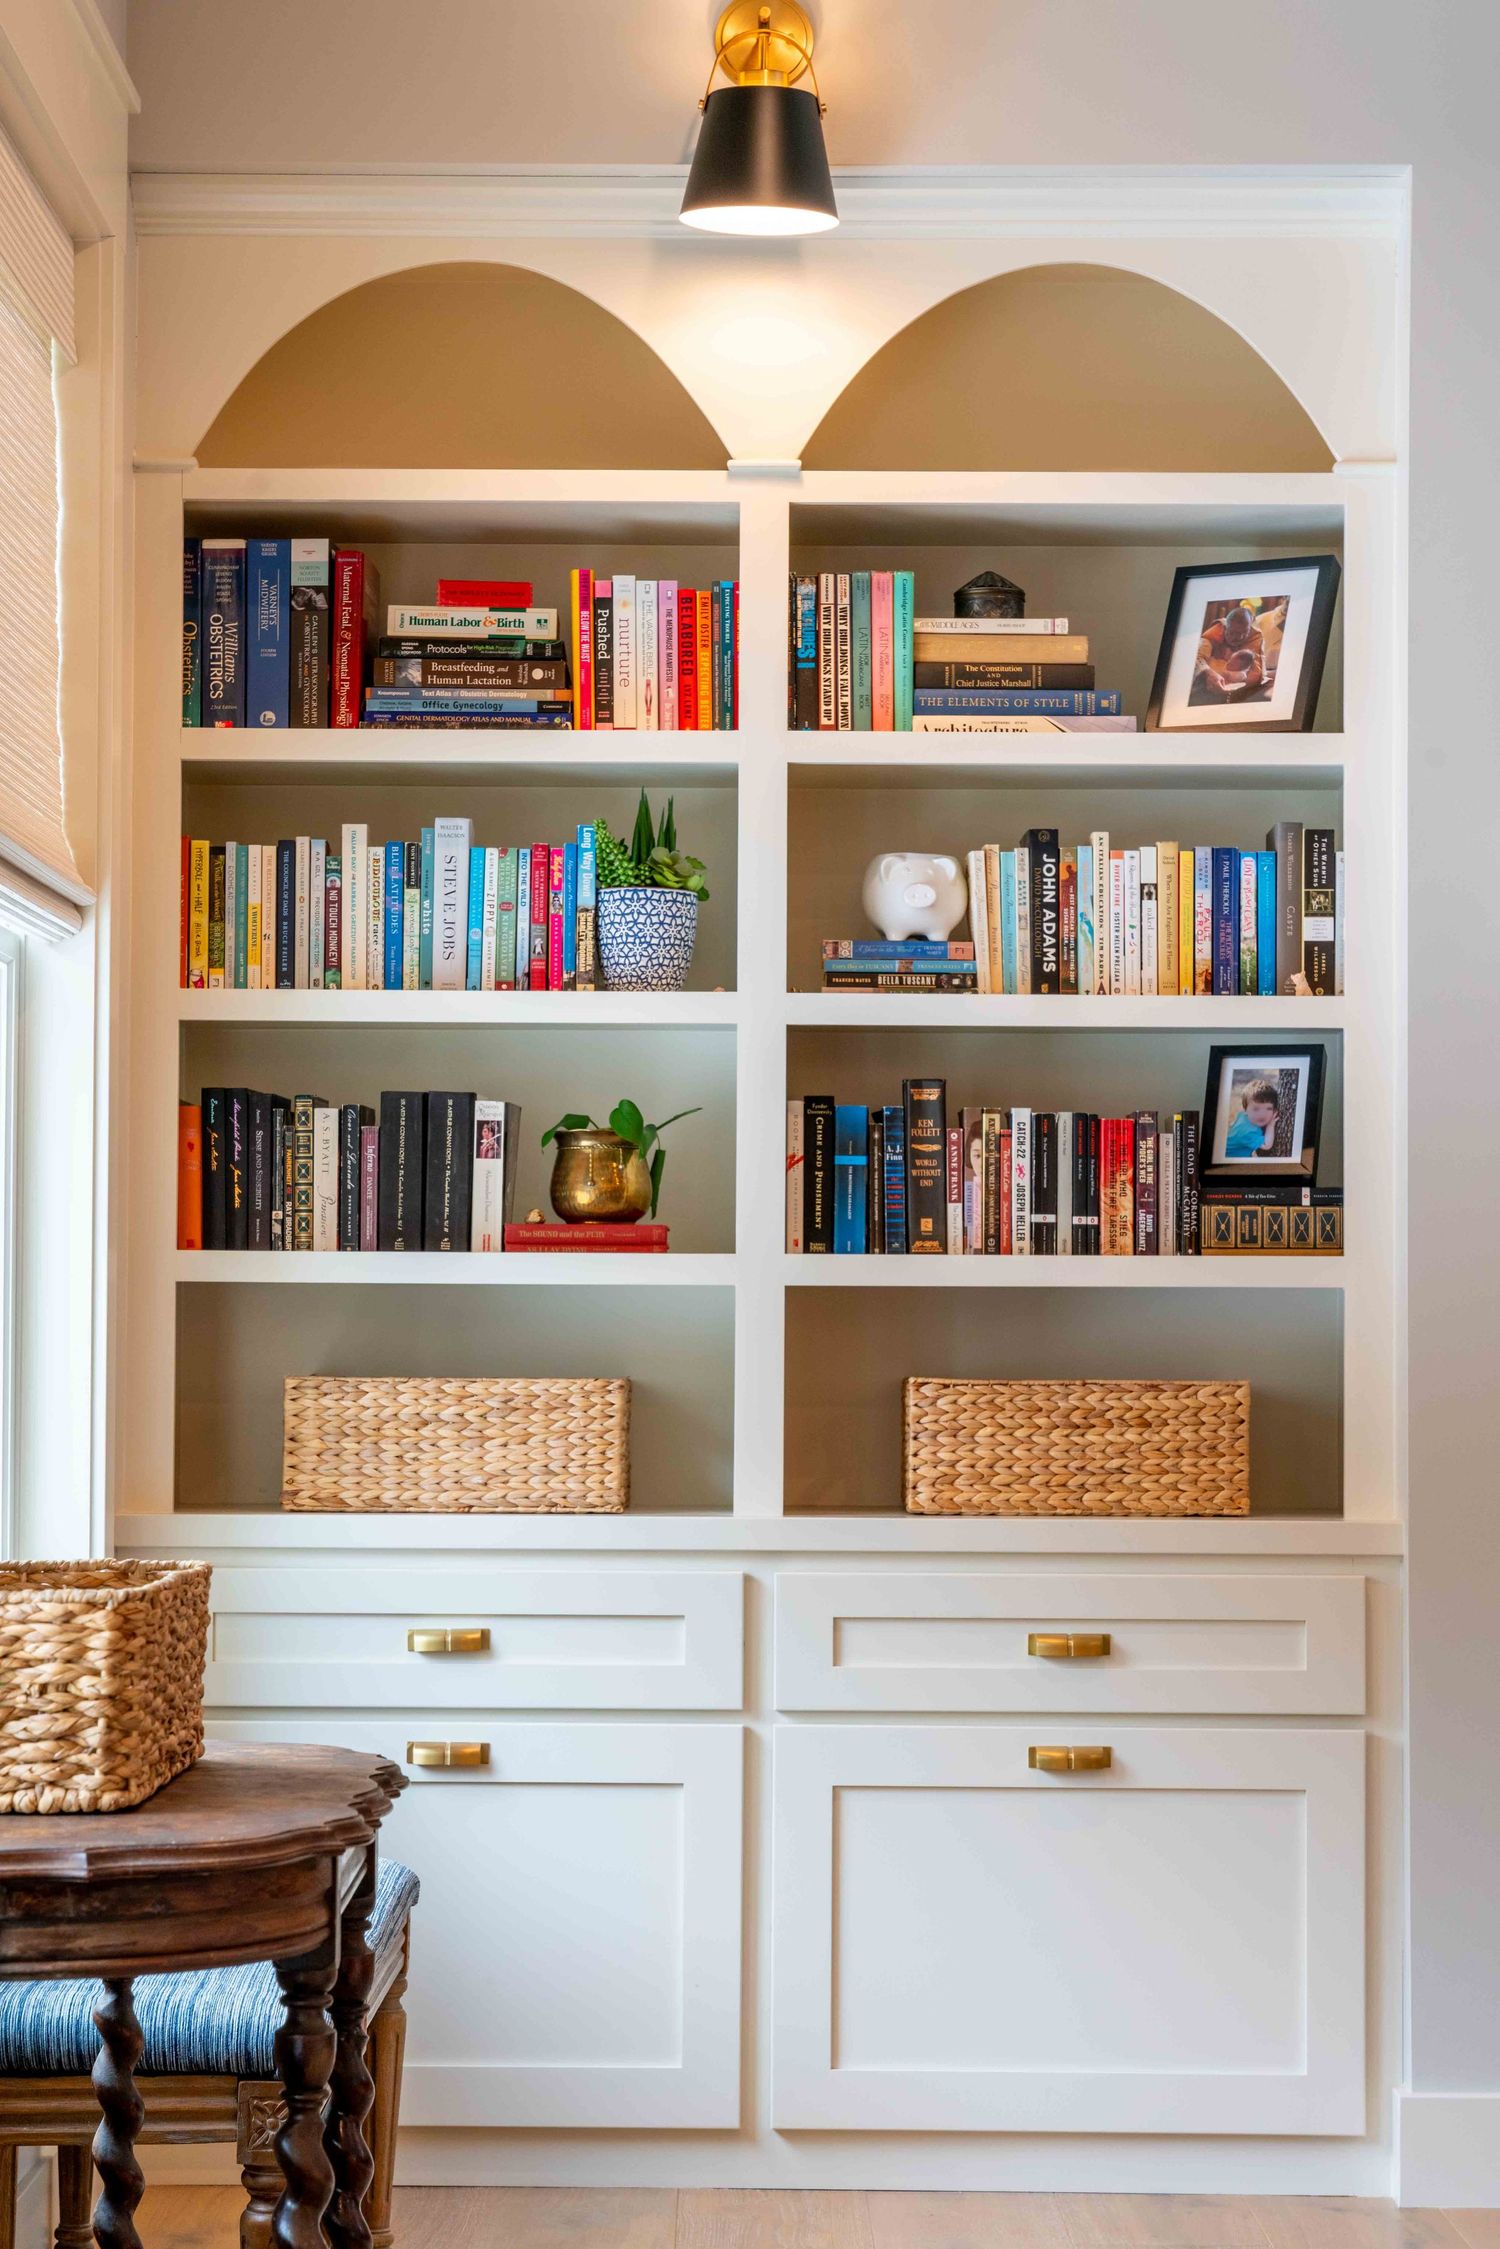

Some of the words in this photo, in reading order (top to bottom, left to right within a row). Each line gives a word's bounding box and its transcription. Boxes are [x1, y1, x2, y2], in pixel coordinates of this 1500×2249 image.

[343, 566, 353, 605] Maternal,
[260, 579, 268, 630] MIDWIFERY
[269, 584, 277, 626] VARNEY'S
[701, 597, 711, 620] EMILY
[823, 606, 832, 626] WHY
[838, 606, 848, 626] WHY
[341, 606, 353, 628] Fetal,
[408, 616, 448, 627] Human
[450, 617, 482, 627] Labor
[482, 616, 497, 628] &
[496, 618, 525, 628] Birth
[581, 610, 590, 631] BELOW
[341, 630, 352, 640] &
[581, 632, 590, 643] THE
[598, 609, 610, 660] Pushed
[681, 596, 693, 676] BELABORED
[701, 624, 711, 648] OSTER
[858, 626, 868, 654] LATIN
[879, 626, 888, 654] LATIN
[183, 621, 198, 696] Obstetrics
[209, 613, 224, 699] OBSTETRICS
[224, 622, 239, 683] Williams
[340, 642, 351, 680] Neonatal
[427, 644, 468, 654] Protocols
[581, 644, 590, 662] WAIST
[619, 618, 632, 688] nurture
[823, 630, 832, 676] BUILDINGS
[838, 629, 848, 675] BUILDINGS
[431, 662, 495, 674] Breastfeeding
[964, 664, 977, 672] The
[980, 664, 1022, 672] Constitution
[428, 676, 464, 686] Human
[466, 676, 512, 686] Lactation
[823, 677, 832, 706] STAND
[838, 678, 848, 700] FALL
[976, 680, 999, 688] Justice
[337, 682, 350, 726] Physiology
[422, 701, 449, 710] Office
[453, 702, 504, 712] Gynecology
[919, 697, 944, 707] THE
[948, 697, 1009, 707] ELEMENTS
[1014, 698, 1029, 708] OF
[1034, 698, 1069, 708] STYLE
[823, 709, 832, 721] UP
[838, 702, 848, 728] DOWN
[581, 827, 594, 848] Long
[582, 852, 594, 870] Way
[443, 855, 457, 914] STEVE
[583, 873, 592, 896] Down
[1042, 853, 1056, 902] JOHN
[282, 890, 288, 899] OF
[330, 890, 338, 901] NO
[372, 858, 380, 922] RIDICULOUS
[330, 903, 338, 928] TOUCH
[422, 900, 431, 934] white
[486, 893, 494, 922] ZIPPY
[1286, 906, 1296, 936] CASTE
[372, 924, 380, 945] race
[443, 918, 457, 960] JOBS
[1042, 908, 1056, 972] ADAMS
[330, 930, 338, 966] MONKEY!
[878, 976, 900, 986] BELLA
[902, 976, 936, 986] TUSCANY
[323, 1112, 330, 1123] A.
[918, 1119, 934, 1127] KEN
[256, 1130, 264, 1151] SENSE
[323, 1126, 330, 1136] S.
[815, 1117, 824, 1146] CRIME
[911, 1128, 941, 1136] FOLLETT
[1017, 1122, 1026, 1158] CATCH-22
[256, 1154, 264, 1168] AND
[364, 1145, 375, 1172] Inferno
[815, 1149, 824, 1167] AND
[886, 1153, 903, 1161] Finn
[256, 1170, 264, 1210] SENSIBILITY
[815, 1171, 824, 1229] PUNISHMENT
[1017, 1182, 1026, 1212] JOSEPH
[1017, 1215, 1026, 1242] HELLER
